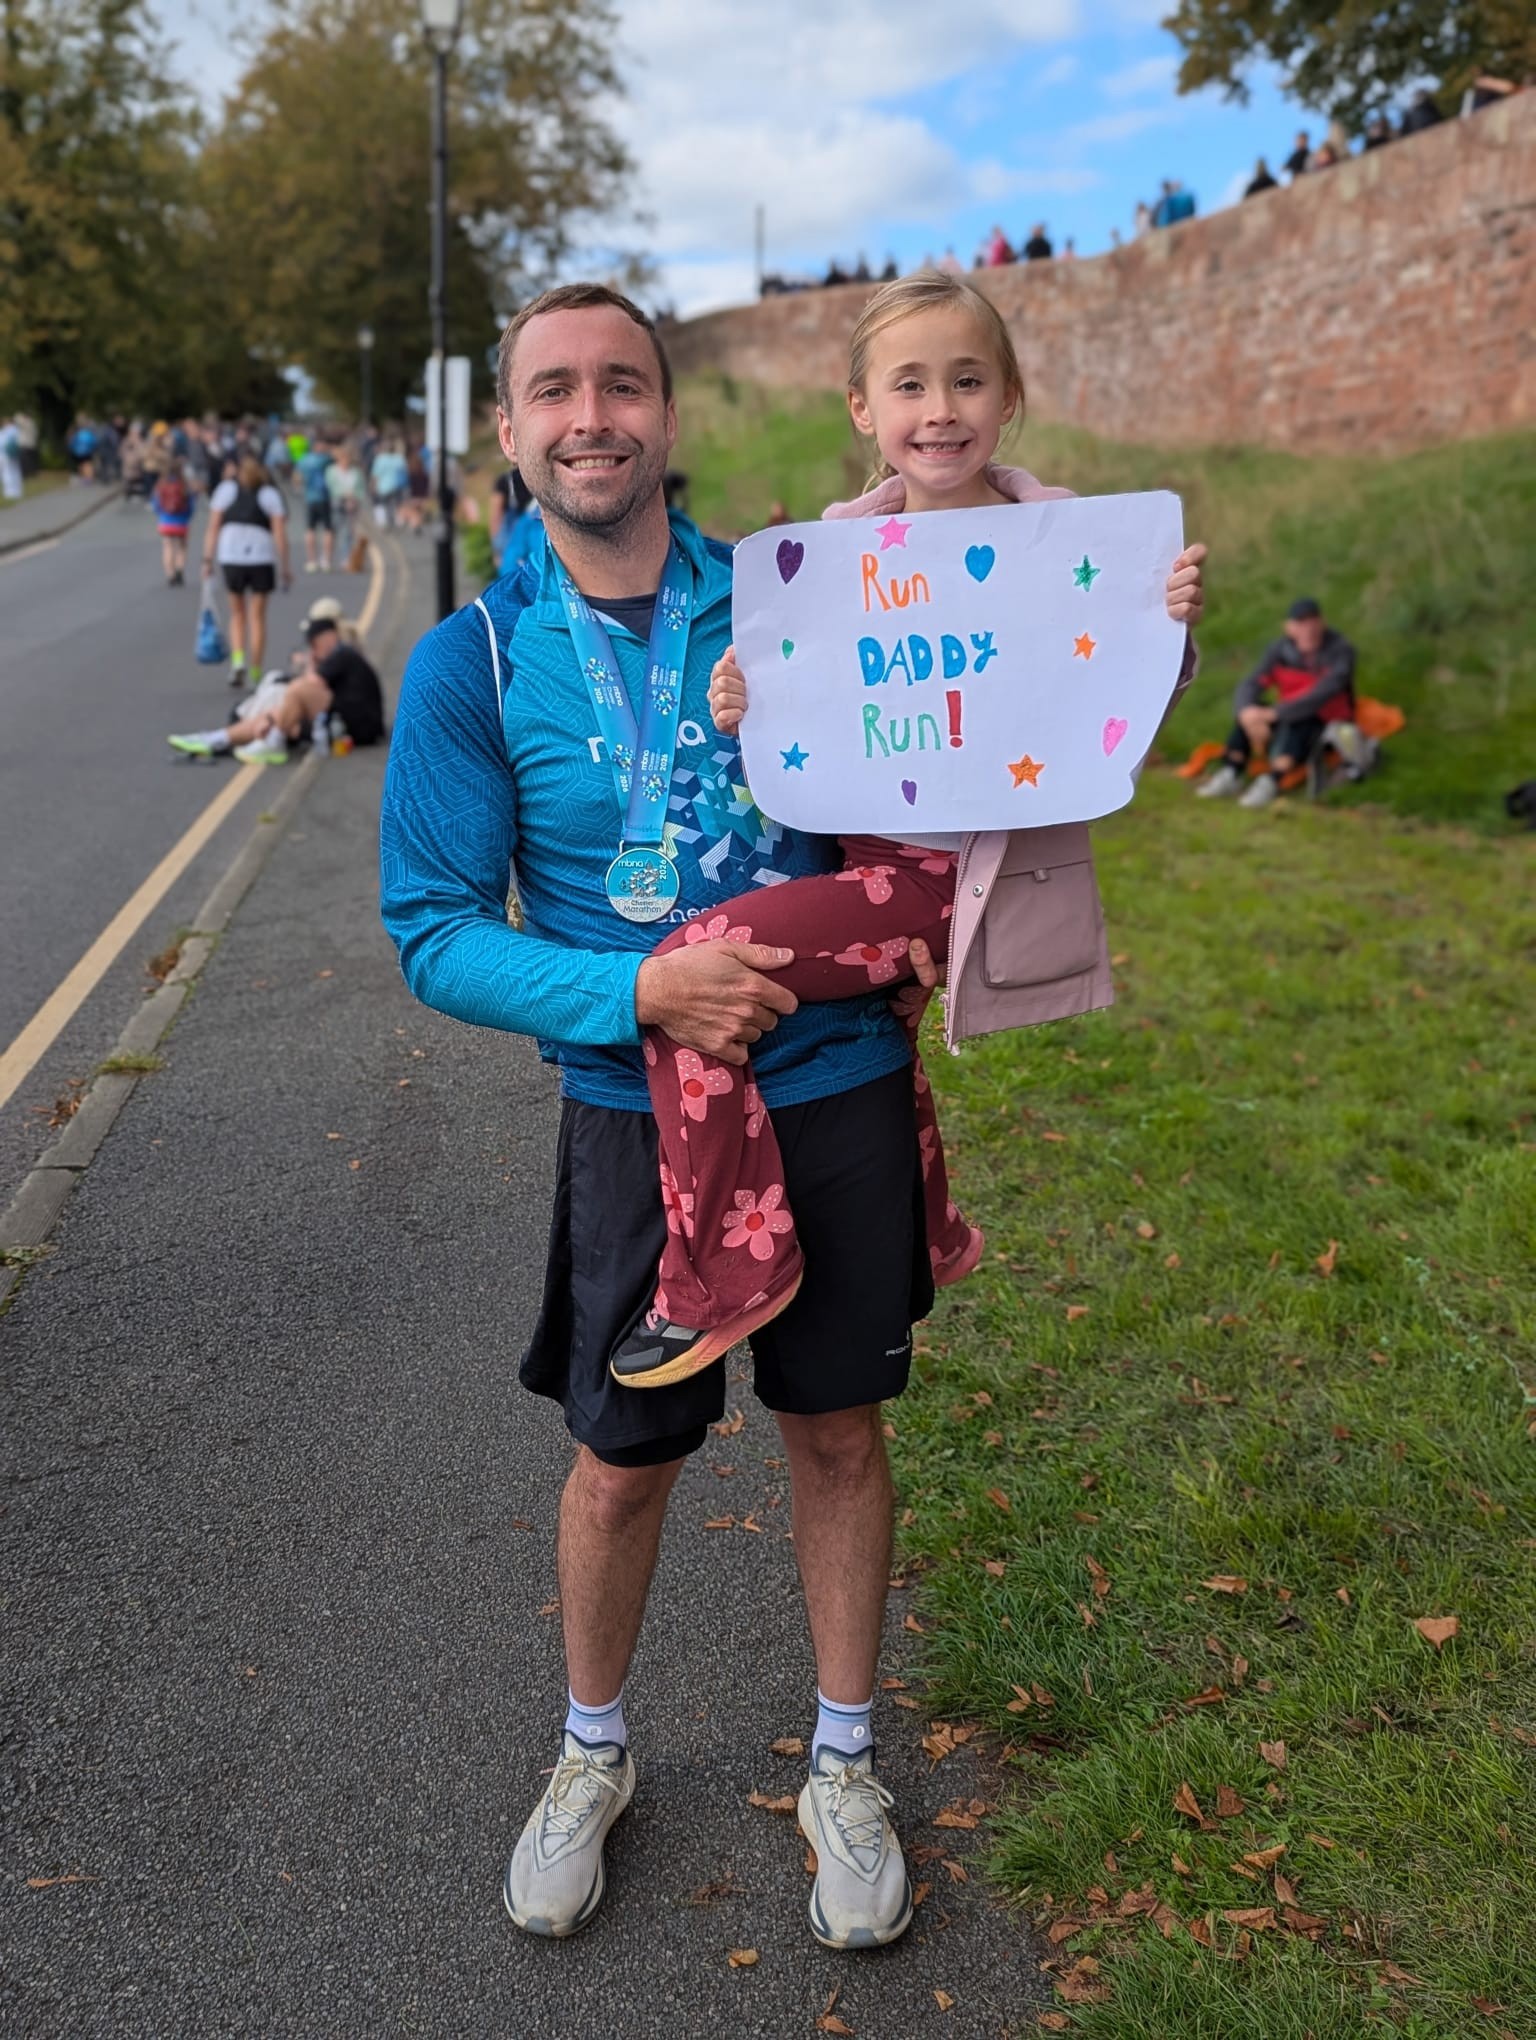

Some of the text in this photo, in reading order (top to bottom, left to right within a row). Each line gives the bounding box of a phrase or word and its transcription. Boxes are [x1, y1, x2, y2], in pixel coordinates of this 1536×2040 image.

[861, 553, 930, 612] Run
[862, 690, 964, 759] Run!
[617, 859, 644, 868] mbna
[659, 859, 667, 880] 2026
[622, 905, 662, 914] Marathon
